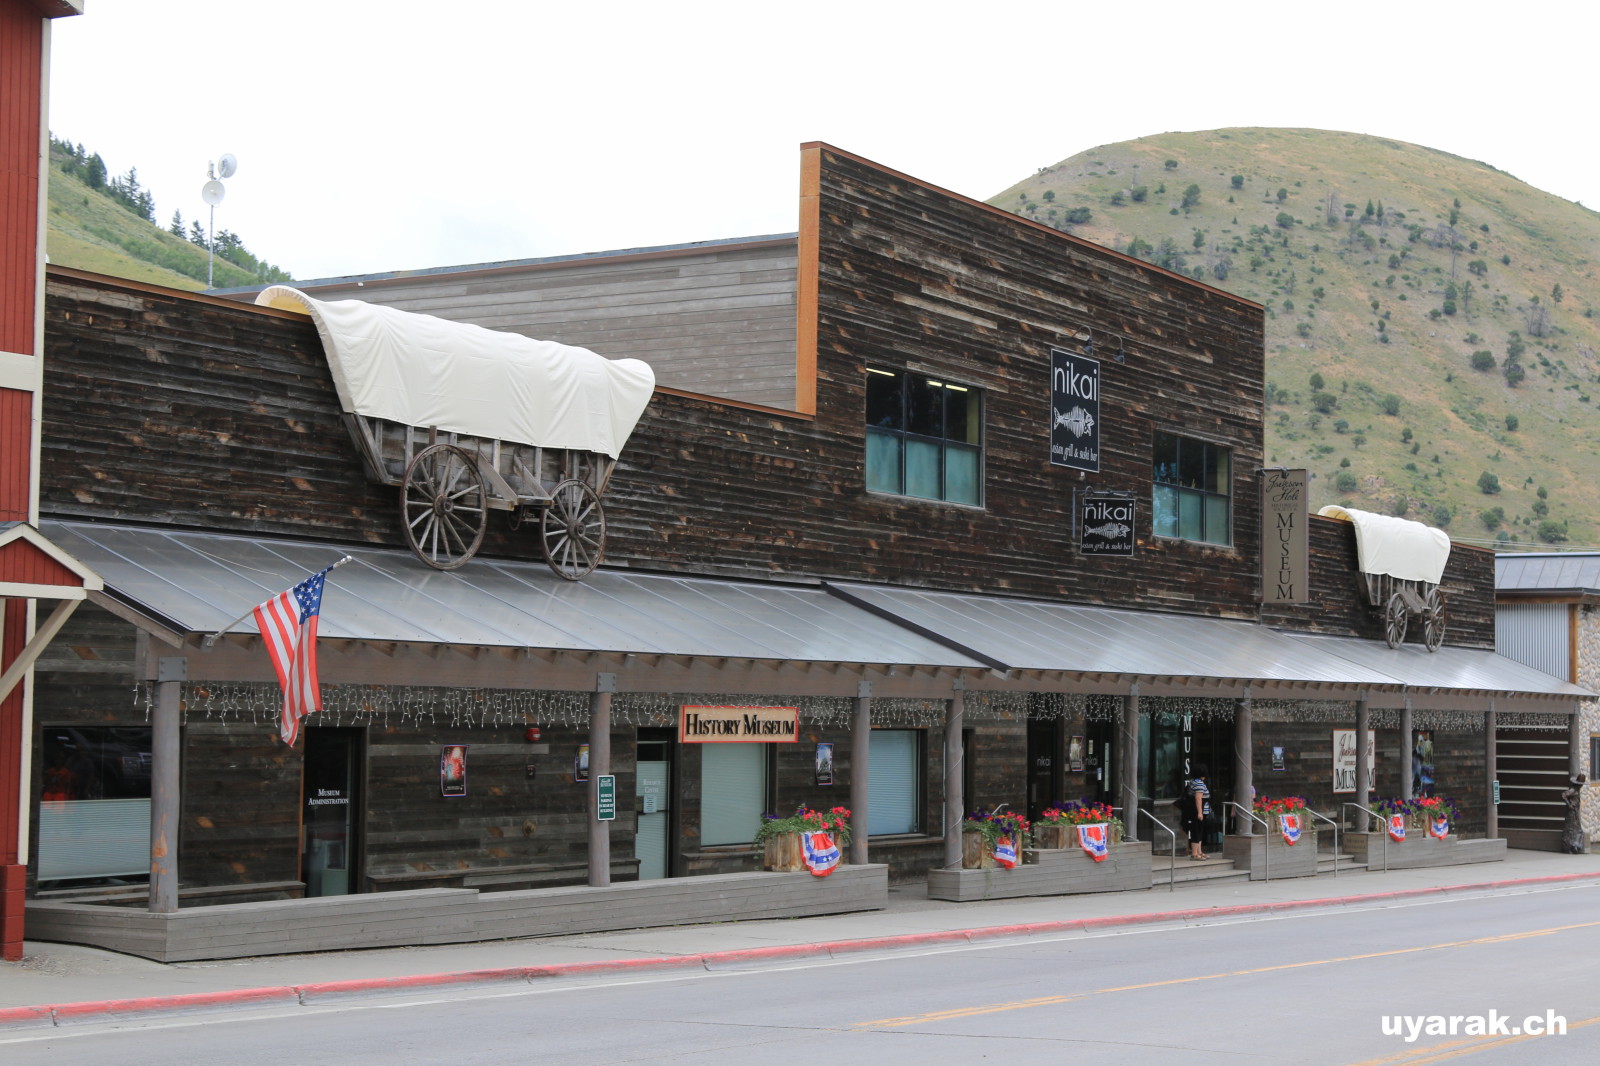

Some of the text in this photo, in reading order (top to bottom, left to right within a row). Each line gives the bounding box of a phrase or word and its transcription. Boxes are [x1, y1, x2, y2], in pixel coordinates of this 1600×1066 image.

[1054, 361, 1097, 401] nikai
[1063, 443, 1074, 461] grill
[1074, 448, 1081, 458] &
[1085, 502, 1133, 521] nikai
[1276, 513, 1294, 600] MUSEUM
[685, 713, 796, 736] HISTORY MUSEUM
[308, 797, 349, 805] ADMINISTRATION
[318, 788, 340, 796] MUSEUM
